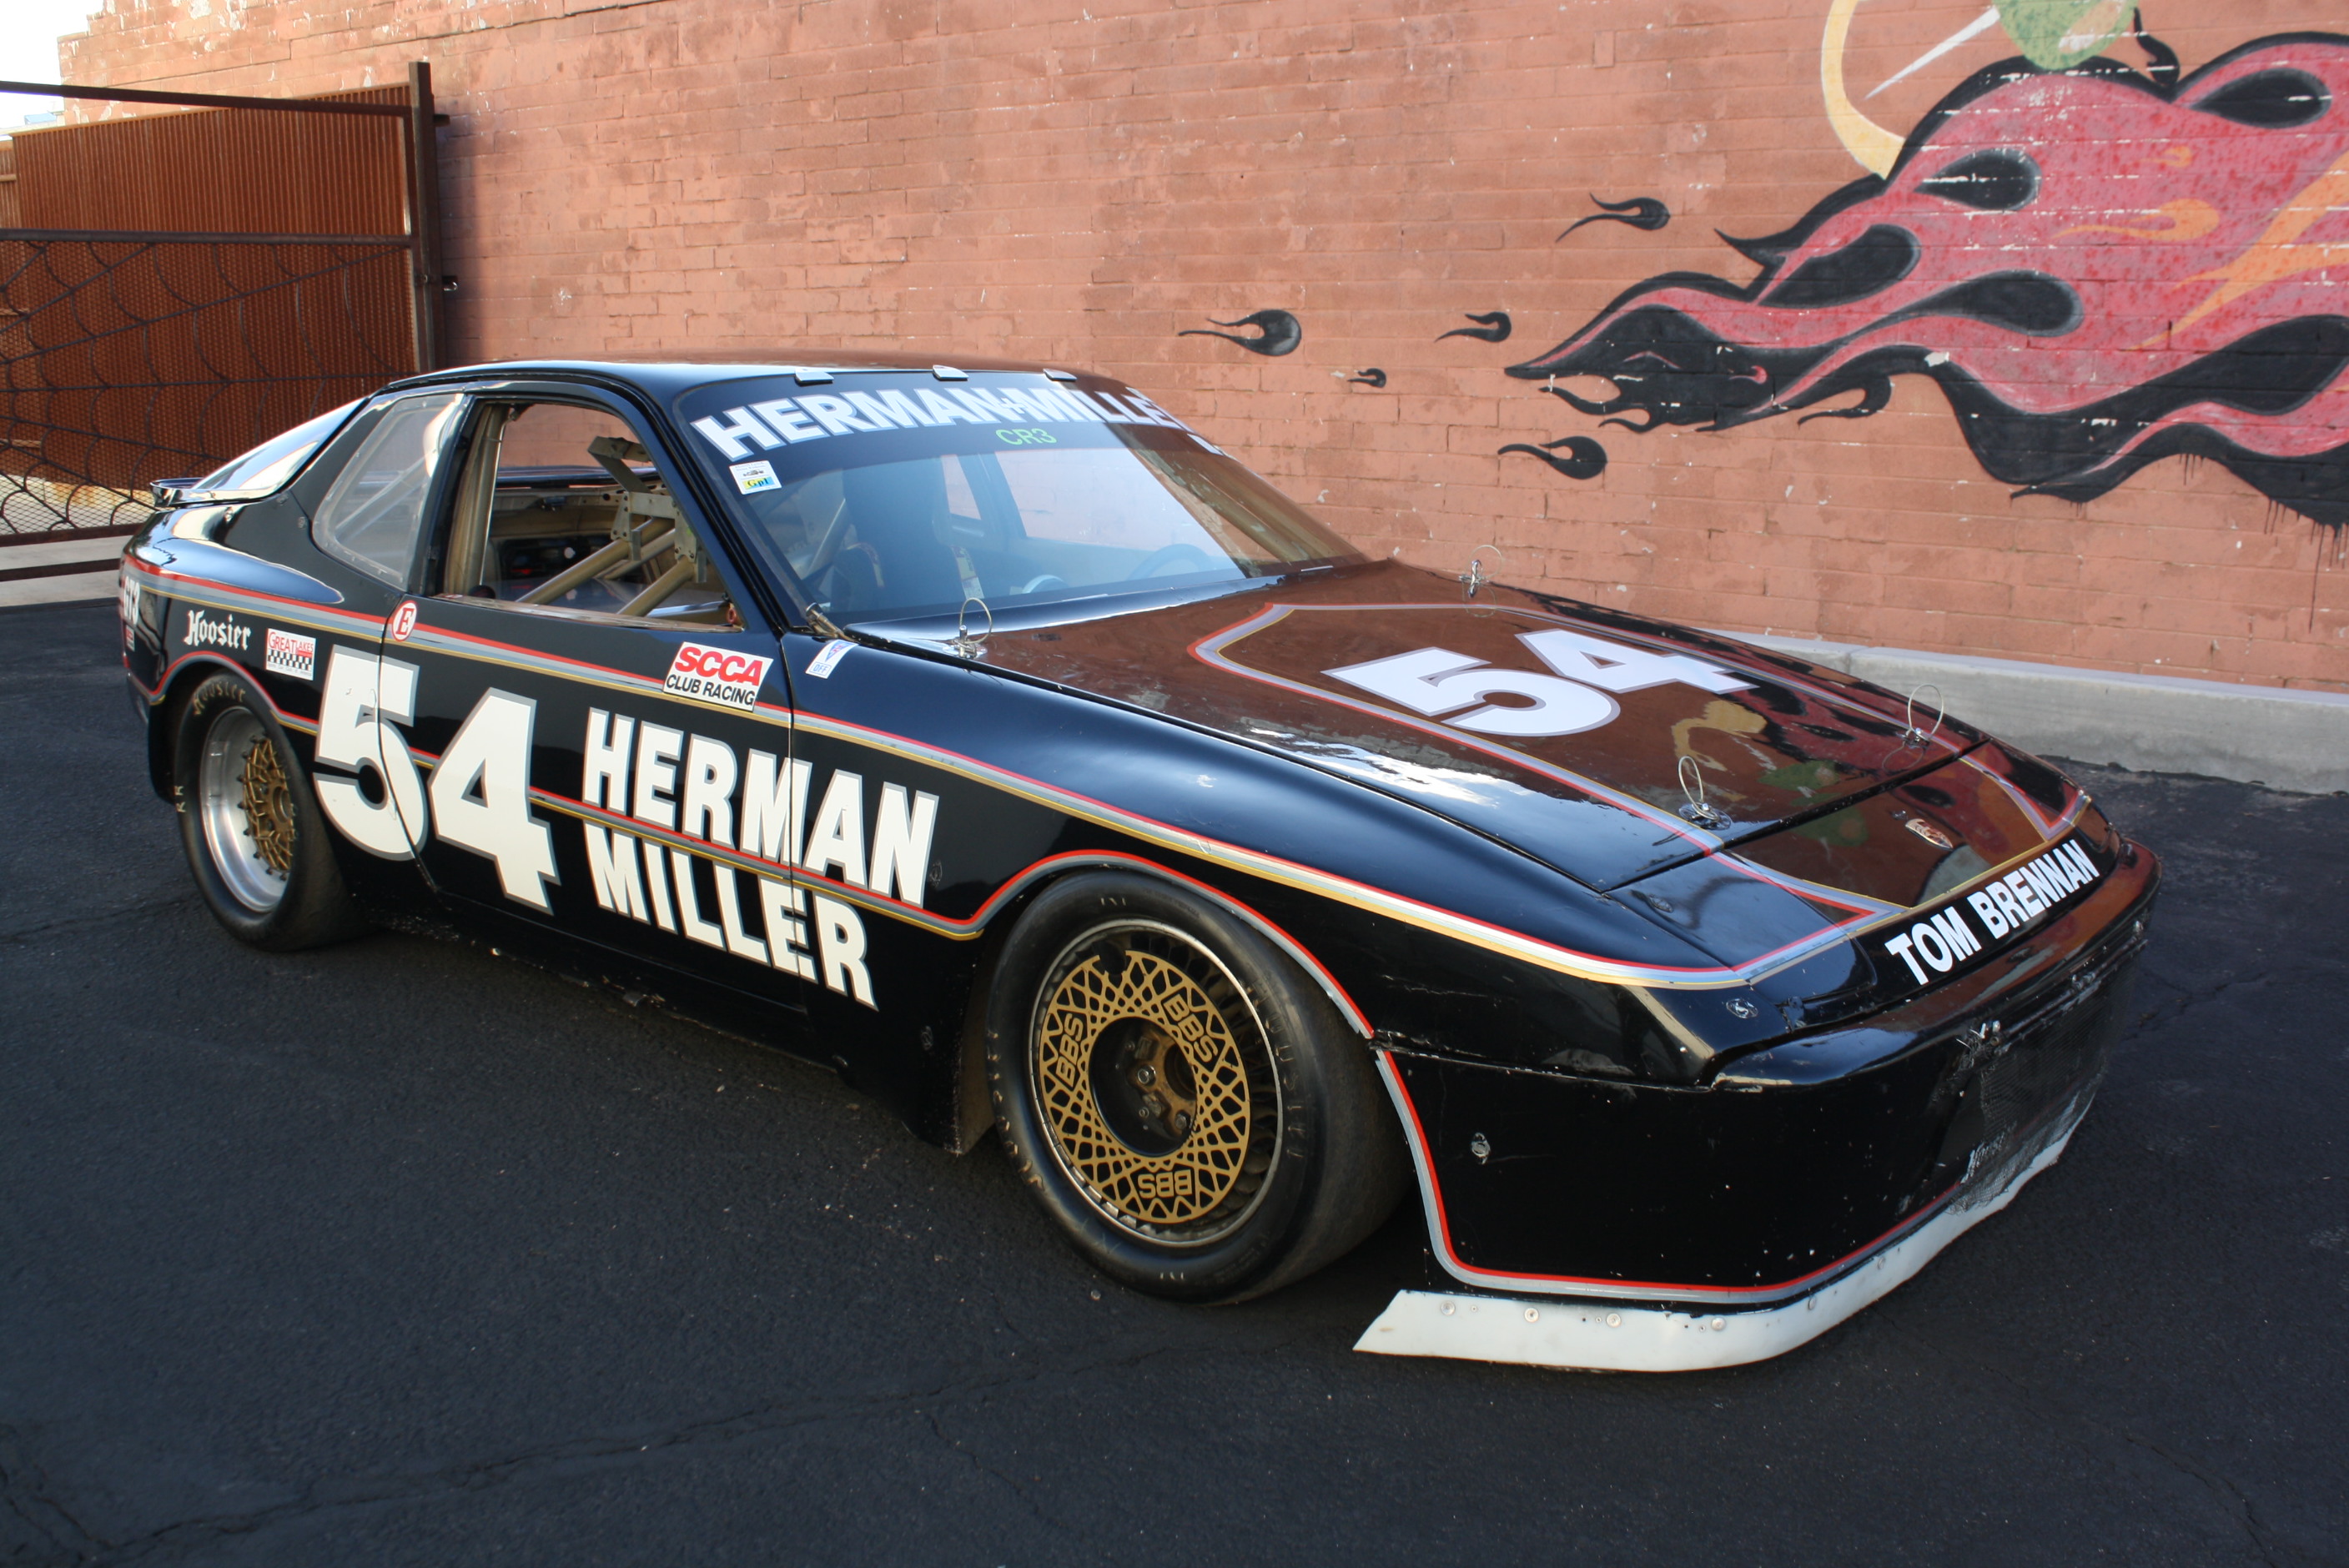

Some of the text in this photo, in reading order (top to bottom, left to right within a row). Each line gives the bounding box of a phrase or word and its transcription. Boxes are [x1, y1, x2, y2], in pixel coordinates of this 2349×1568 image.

[995, 427, 1058, 445] CR3
[184, 610, 252, 651] Hoosier
[395, 607, 415, 636] E
[269, 631, 298, 655] GREAT
[674, 646, 764, 686] SCCA
[812, 664, 828, 674] OFF
[1320, 628, 1759, 737] 54
[666, 674, 756, 706] CLUB RACING
[313, 644, 561, 916] 54
[583, 706, 940, 909] HERMAN
[583, 820, 879, 1012] MILLER
[1884, 839, 2100, 986] TOM BRENNAN
[1162, 993, 1219, 1063] BBS
[1055, 1013, 1084, 1088] BBS
[1137, 1169, 1194, 1199] BBS
